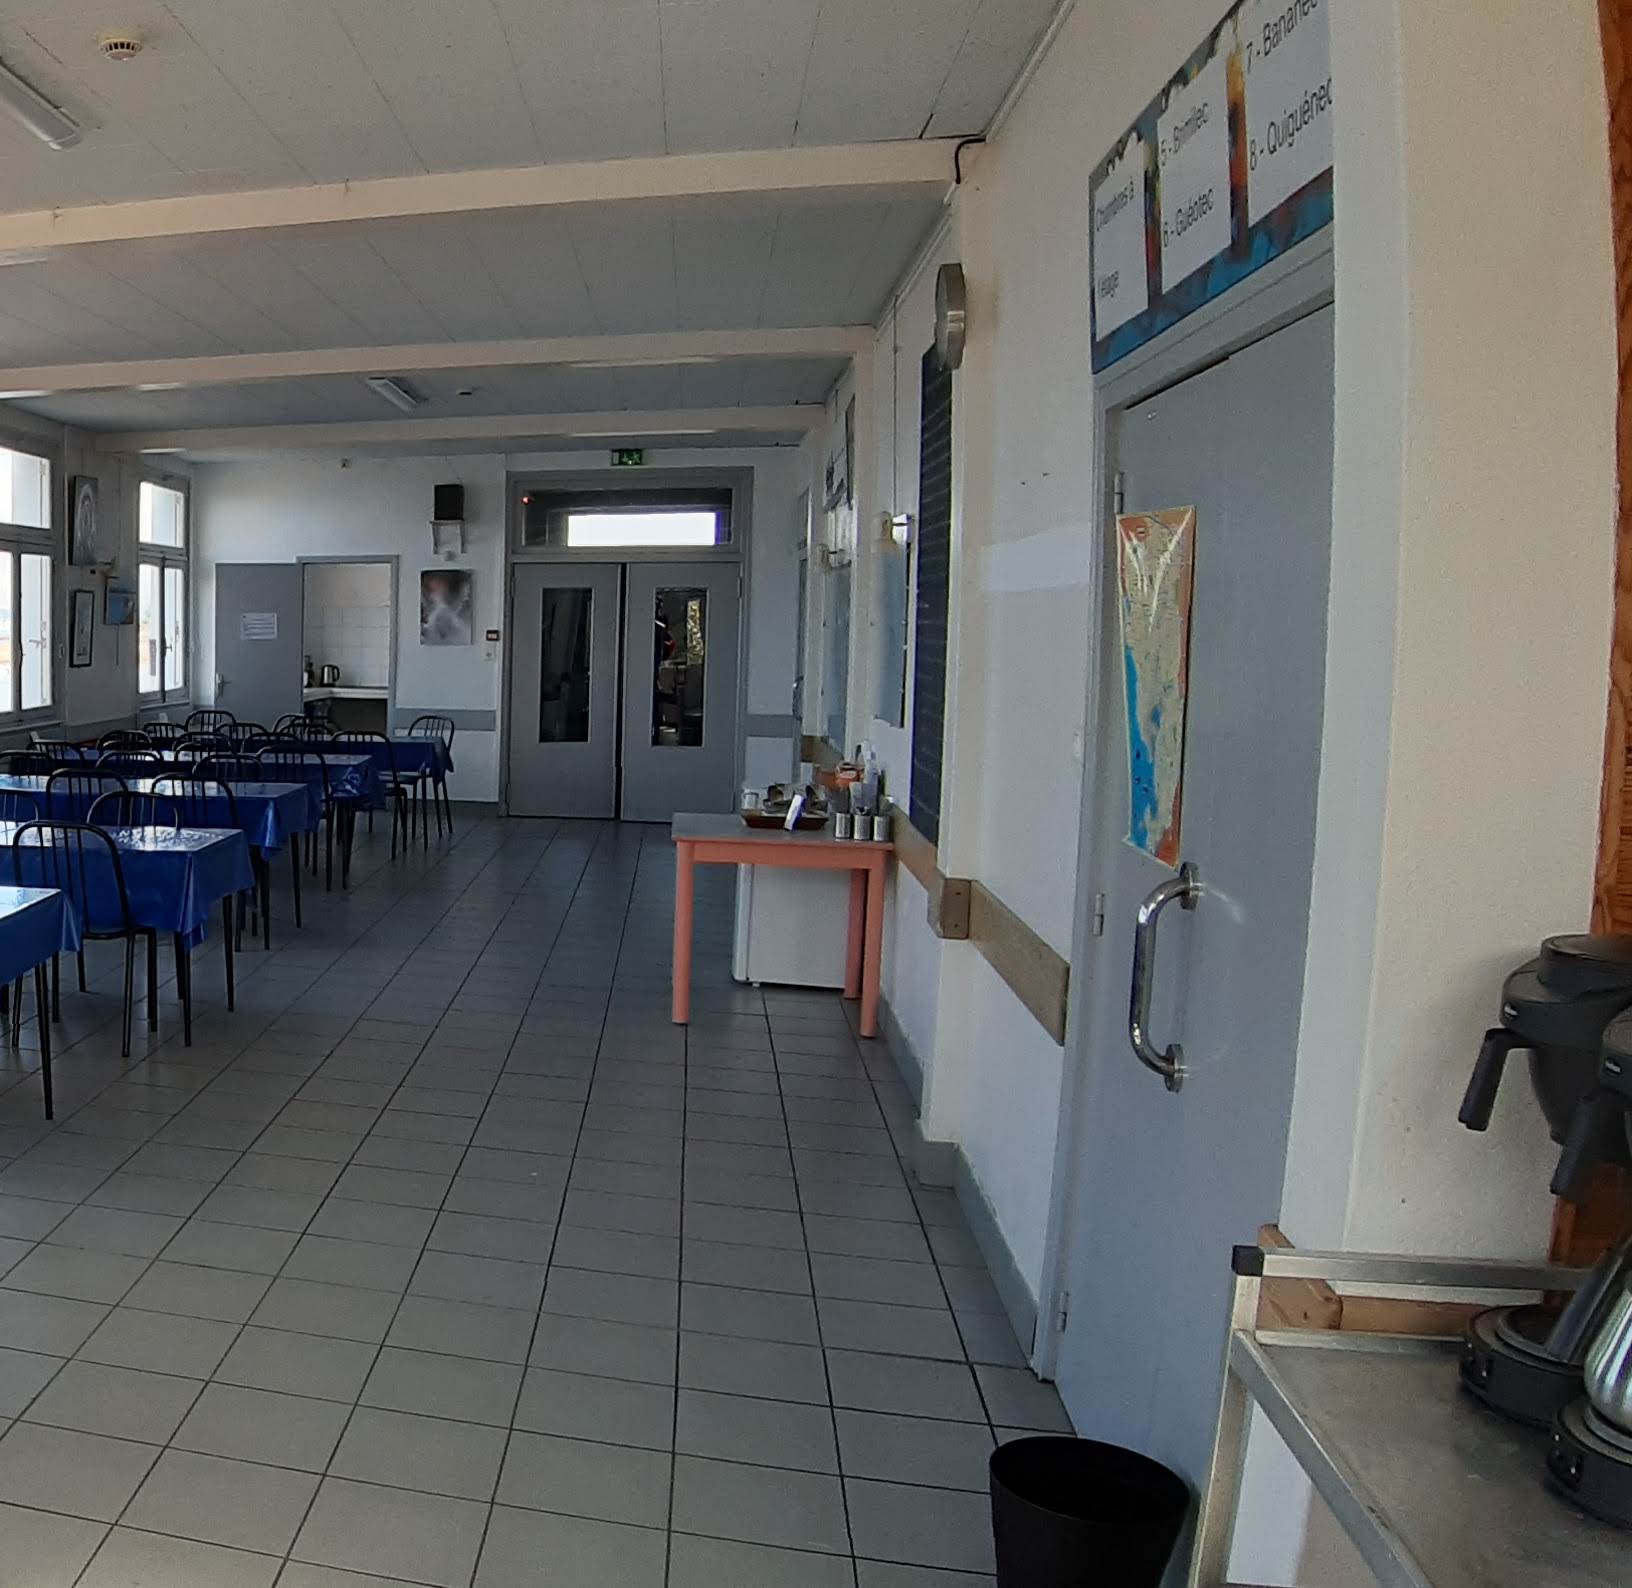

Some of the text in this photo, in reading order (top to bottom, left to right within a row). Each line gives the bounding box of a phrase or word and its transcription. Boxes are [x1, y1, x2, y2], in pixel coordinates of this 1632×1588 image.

[1246, 40, 1253, 74] 7
[1161, 138, 1168, 167] 5
[1249, 138, 1257, 171] 8
[1164, 220, 1169, 247] 6
